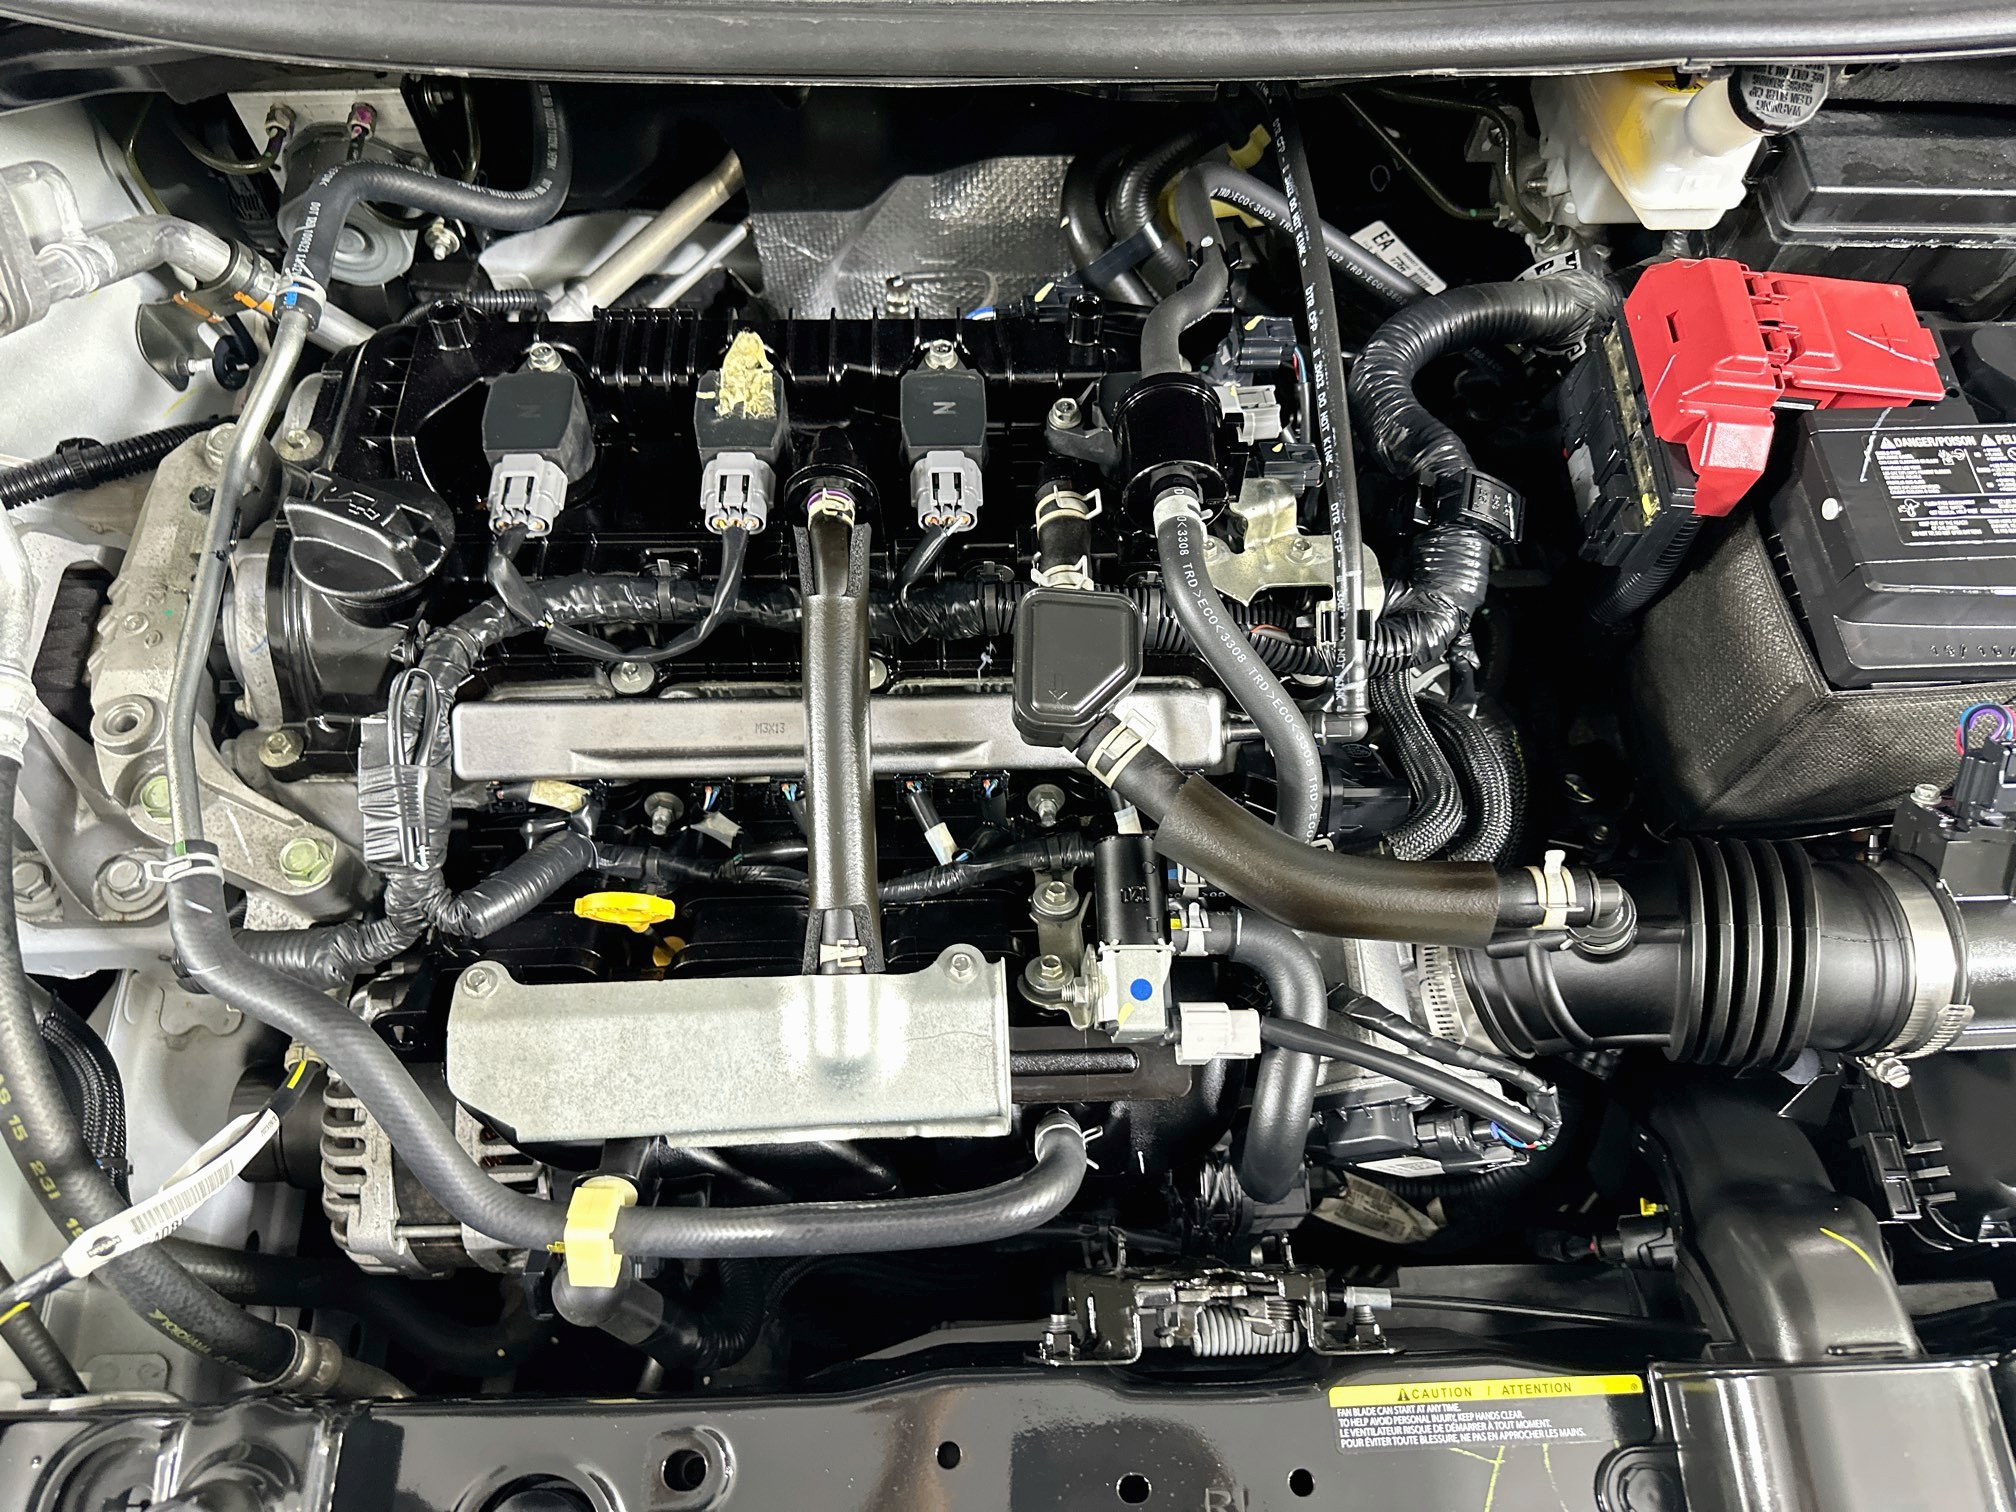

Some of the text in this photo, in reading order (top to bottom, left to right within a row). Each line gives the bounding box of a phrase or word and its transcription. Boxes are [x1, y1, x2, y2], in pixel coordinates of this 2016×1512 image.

[1756, 100, 1801, 117] WARNING
[1371, 230, 1396, 252] EA
[1305, 285, 1316, 309] DTR
[1308, 309, 1318, 332] CFP
[1317, 392, 1327, 408] DO
[1318, 412, 1330, 433] NOT
[1322, 437, 1334, 466] KINK
[1893, 435, 1978, 448] DANGER/POISON
[1330, 502, 1339, 526] DTR
[1333, 530, 1344, 553] CFP
[1336, 649, 1347, 670] NOT
[755, 722, 785, 735] M3X13
[1411, 1387, 1472, 1399] CAUTION
[1502, 1382, 1572, 1395] ATTENTION
[1336, 1402, 1461, 1417] FAN BLADE CAN START AT ANY TIME.
[1338, 1418, 1350, 1427] TO
[1350, 1417, 1369, 1427] HELP
[1370, 1415, 1393, 1426] AVOID
[1393, 1413, 1431, 1425] PERSONAL
[1457, 1412, 1474, 1421] KEEP
[1475, 1410, 1500, 1420] HANDS
[1501, 1409, 1525, 1419] CLEAR.
[1339, 1428, 1350, 1438] LE
[1350, 1425, 1402, 1437] VENTILATEUR
[1403, 1424, 1432, 1435] RISQUE
[1432, 1423, 1444, 1433] DE
[1444, 1421, 1487, 1433] DÉMARRER
[1494, 1420, 1515, 1430] TOUT
[1516, 1419, 1552, 1429] MOMENT.
[1341, 1427, 1587, 1448] POUR ÉVITER TOUTE BLESSURE, NE PAS EN APPROCHER LES MAINS.
